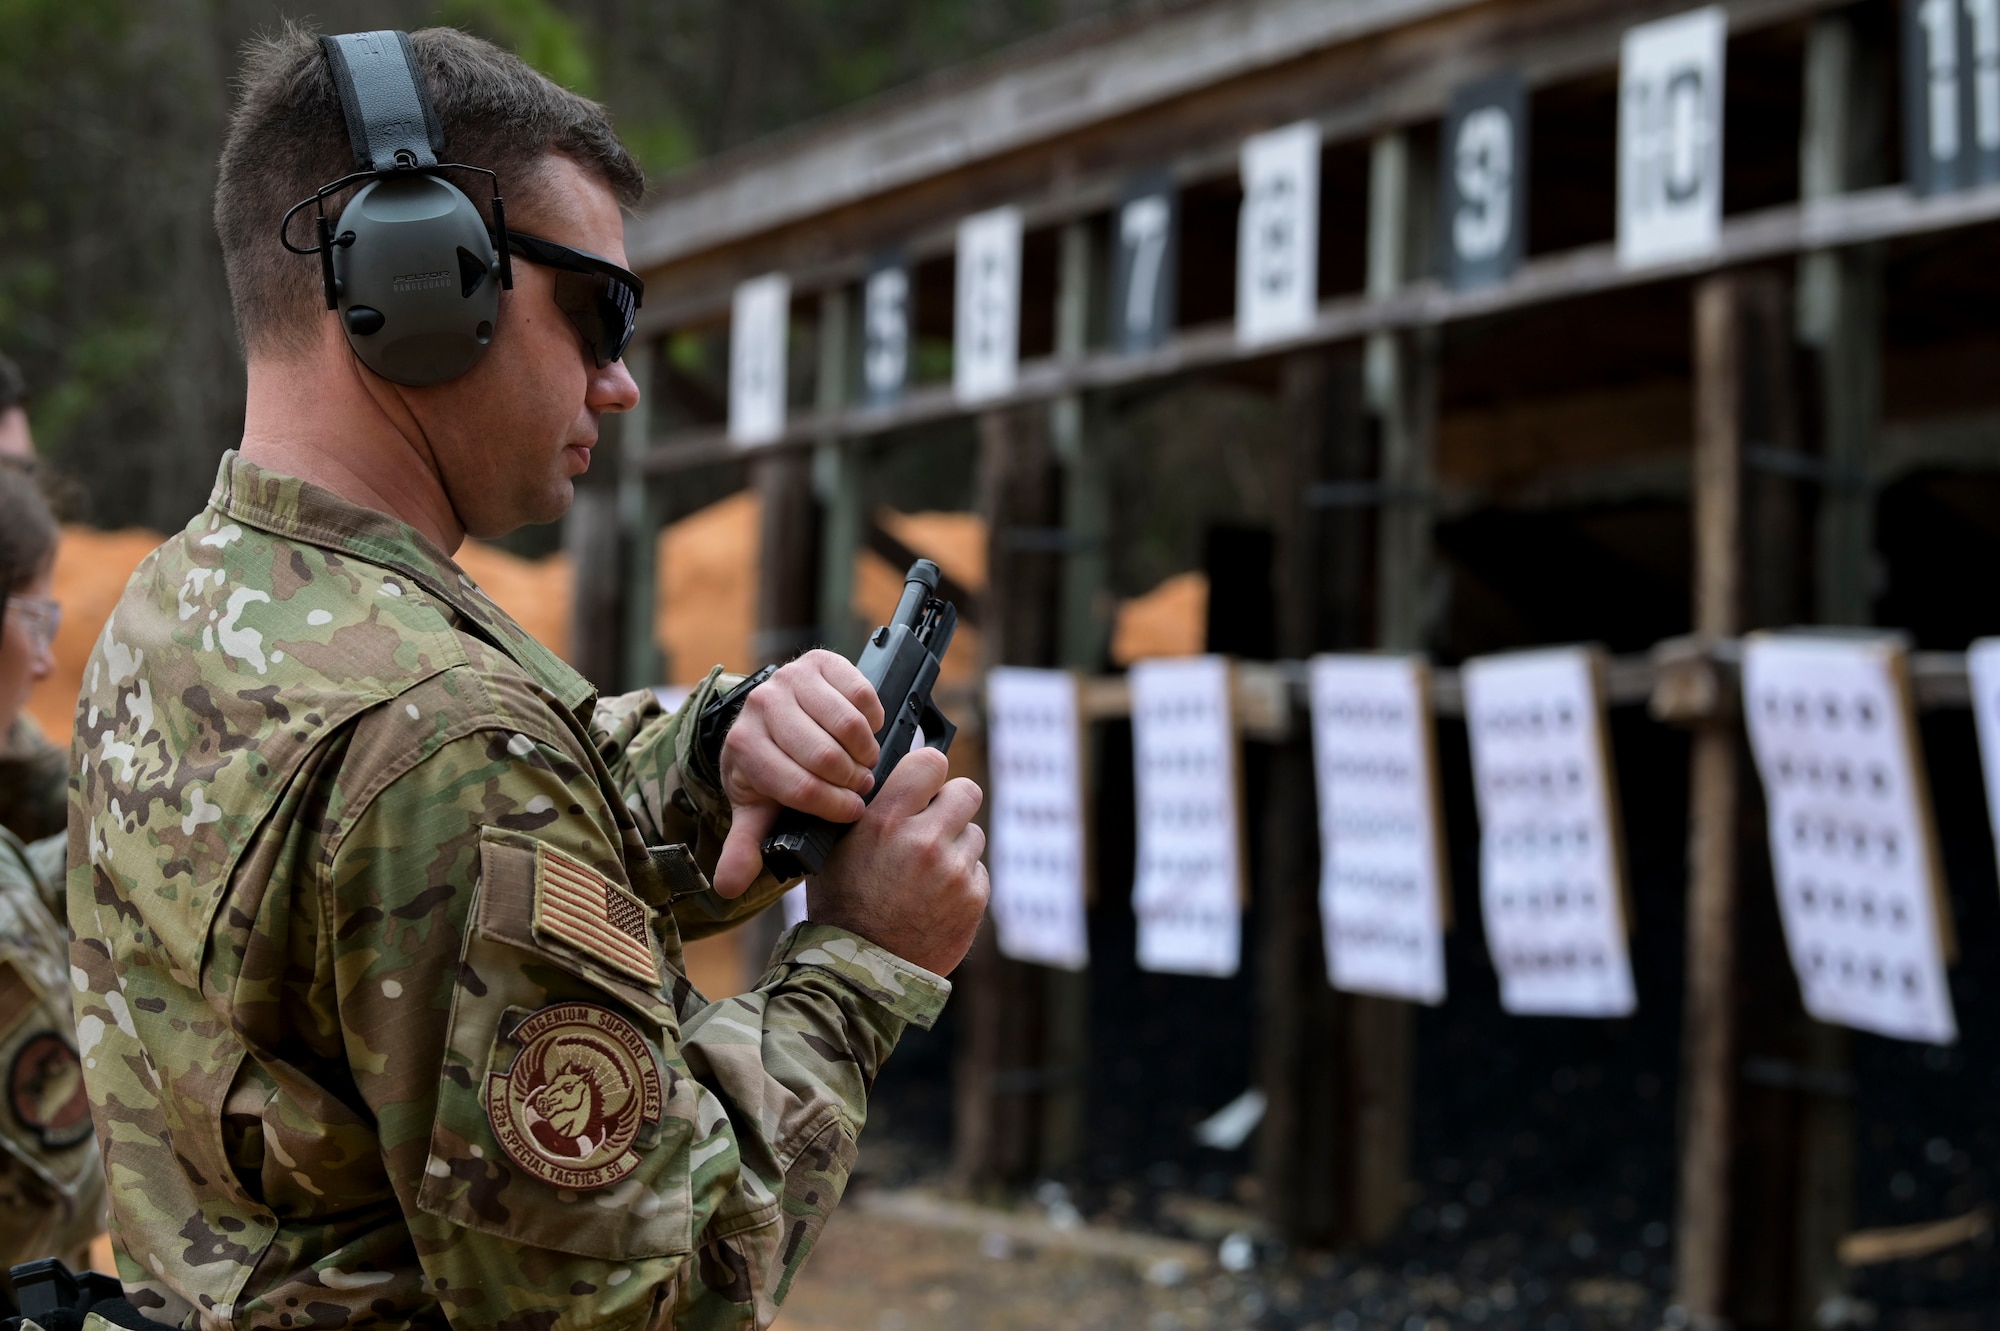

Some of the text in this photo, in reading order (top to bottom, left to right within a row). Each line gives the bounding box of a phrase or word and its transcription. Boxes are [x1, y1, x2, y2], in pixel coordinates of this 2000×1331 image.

[1453, 105, 1514, 261] 9
[1629, 65, 1711, 219] 10
[392, 270, 450, 284] PELTOR
[393, 278, 452, 293] RANGEGUARD
[1120, 195, 1170, 333] 7
[522, 1009, 658, 1114] INGENIUM SUPERAT VIRES
[502, 1130, 546, 1176] SPECIAL
[549, 1167, 603, 1186] TACTICS
[607, 1162, 623, 1179] SQ
